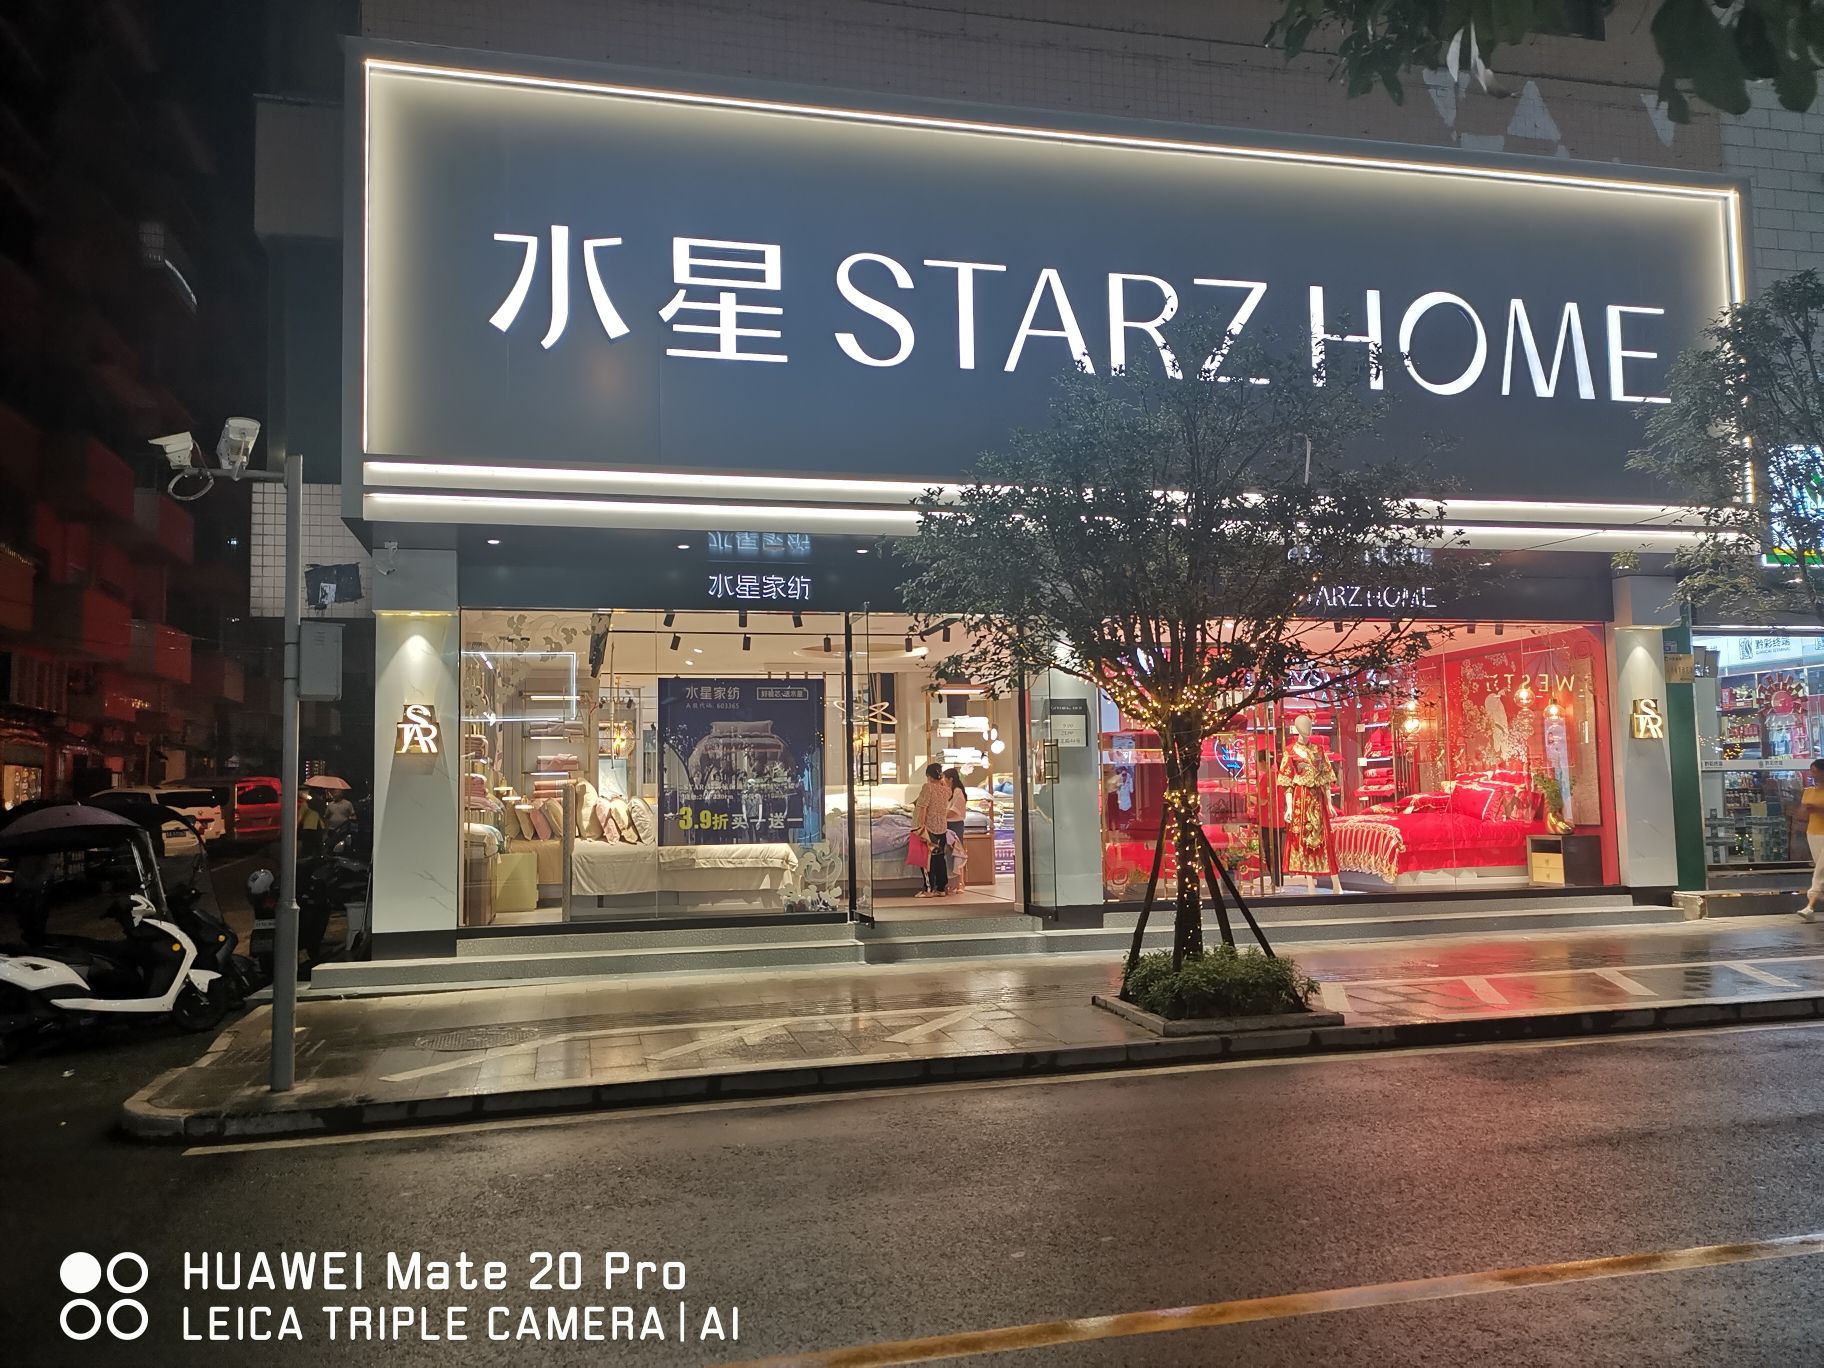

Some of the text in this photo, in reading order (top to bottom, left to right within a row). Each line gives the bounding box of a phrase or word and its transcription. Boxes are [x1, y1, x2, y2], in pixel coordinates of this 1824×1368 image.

[488, 224, 1672, 404] 水星 STARZ HOME
[707, 573, 812, 600] 水星家纺
[1367, 586, 1438, 608] HOME
[685, 685, 740, 701] 水星家纺
[679, 805, 804, 831] 3.9折 买一送一
